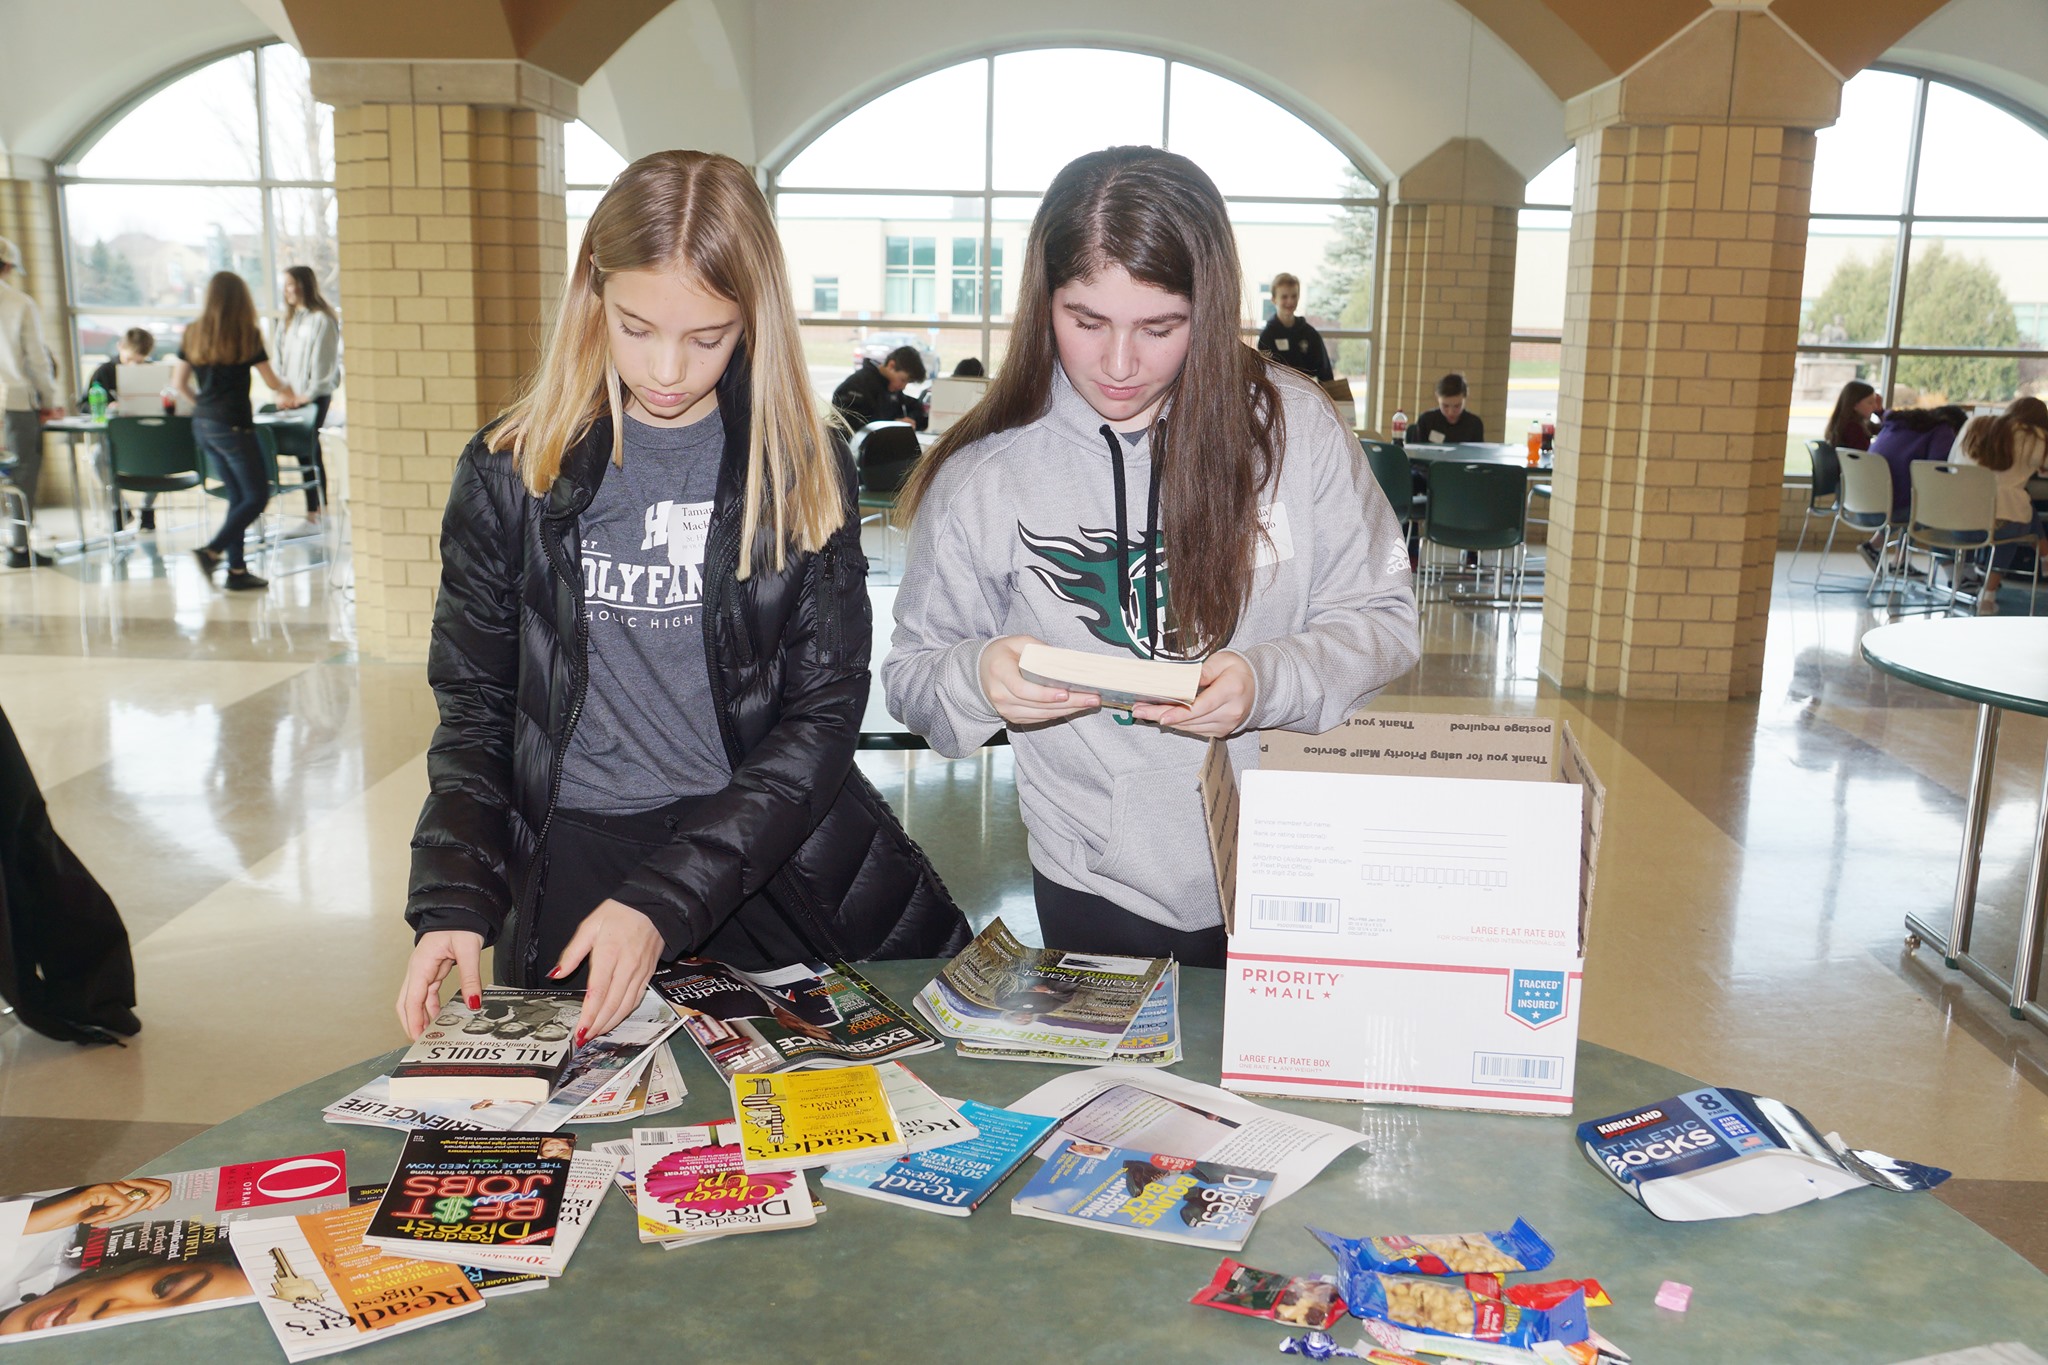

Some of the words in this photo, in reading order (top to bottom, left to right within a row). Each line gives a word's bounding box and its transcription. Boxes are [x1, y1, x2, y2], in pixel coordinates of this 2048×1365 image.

[682, 506, 714, 518] Tamar
[682, 521, 710, 532] Mack
[582, 539, 598, 549] ST
[581, 556, 645, 602] OLY
[651, 614, 693, 628] HIGH
[1354, 718, 1377, 729] you
[1378, 718, 1414, 730] Thank
[1450, 721, 1500, 732] required
[1504, 723, 1552, 734] postage
[1303, 746, 1346, 757] Service
[1384, 747, 1427, 761] Priority
[1430, 749, 1463, 761] using
[1466, 751, 1483, 762] for
[1486, 752, 1509, 762] you
[1510, 752, 1548, 765] Thank
[1471, 926, 1498, 935] LARGE
[1501, 927, 1521, 936] FLAT
[1524, 928, 1546, 938] RATE
[1548, 929, 1566, 939] BOX
[1022, 969, 1078, 984] Planet
[1034, 965, 1081, 976] People
[1083, 971, 1138, 982] Healthy
[666, 977, 730, 996] Health
[1078, 975, 1149, 990] Healthy
[671, 984, 754, 1004] Mindful
[1265, 986, 1316, 1000] MAIL
[846, 1013, 889, 1030] DETOX
[847, 1016, 896, 1035] WHOLE
[964, 1024, 1108, 1049] EXPERIENCE
[427, 1047, 502, 1060] SOULS
[515, 1050, 557, 1062] ALL
[1239, 1054, 1266, 1064] LARGE
[1268, 1056, 1288, 1065] FLAT
[1290, 1057, 1312, 1067] RATE
[1314, 1058, 1331, 1068] BOX
[1239, 1062, 1253, 1070] ONE
[800, 1096, 873, 1109] CRIMINALS
[817, 1102, 858, 1112] DUMB
[1695, 1093, 1722, 1111] 8
[384, 1106, 484, 1131] ERIENCE
[1707, 1107, 1730, 1116] PAIRS
[1597, 1109, 1663, 1134] KIRKLAND
[1718, 1115, 1736, 1124] FITS
[802, 1127, 859, 1139] digest
[1596, 1120, 1701, 1157] ATHLETIC
[747, 1131, 890, 1158] Reader's
[1606, 1128, 1717, 1178] SOCKS
[679, 1163, 703, 1171] Alive
[915, 1156, 955, 1169] Everyday
[921, 1161, 962, 1175] Solutions
[954, 1163, 963, 1171] to
[1654, 1156, 1681, 1168] MOISTURE
[664, 1169, 691, 1177] Great
[700, 1167, 714, 1175] It's
[895, 1165, 951, 1186] digest
[960, 1168, 988, 1180] 50
[256, 1158, 342, 1199] O
[695, 1171, 749, 1193] Up!
[360, 1188, 382, 1196] MORE
[403, 1174, 552, 1198] JOBS
[241, 1181, 252, 1207] OPRAH
[673, 1184, 777, 1204] Cheer
[1079, 1176, 1127, 1219] ANYTHING
[1117, 1181, 1167, 1217] BACK
[1131, 1175, 1199, 1227] BOUNCE
[1096, 1194, 1130, 1219] FROM
[1195, 1173, 1259, 1230] Digest
[1228, 1190, 1261, 1226] Reader's
[397, 1219, 532, 1240] Digest
[686, 1214, 761, 1231] Reader's
[202, 1221, 217, 1244] MOST
[123, 1231, 135, 1250] word
[526, 1255, 551, 1265] 20
[366, 1262, 430, 1285] SECRETS
[382, 1262, 403, 1274] Fixes
[349, 1270, 374, 1282] Tips!
[351, 1265, 450, 1297] HOMEOWNER
[351, 1285, 424, 1310] digest
[285, 1286, 471, 1337] Reader's
